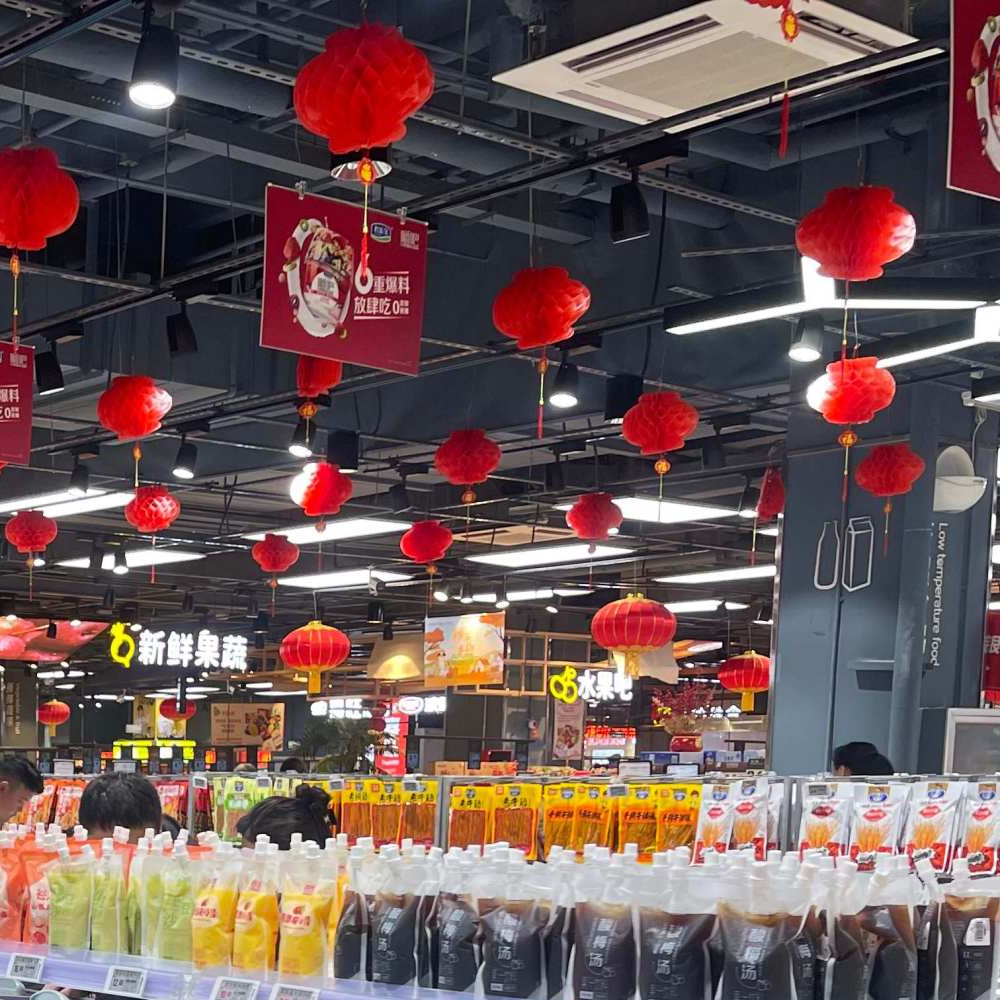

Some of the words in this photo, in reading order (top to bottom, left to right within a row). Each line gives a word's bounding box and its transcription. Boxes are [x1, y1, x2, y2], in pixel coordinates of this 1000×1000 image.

[938, 523, 949, 551] Low
[932, 553, 947, 634] temperature
[138, 628, 248, 671] 新鲜果蔬
[930, 637, 942, 666] food
